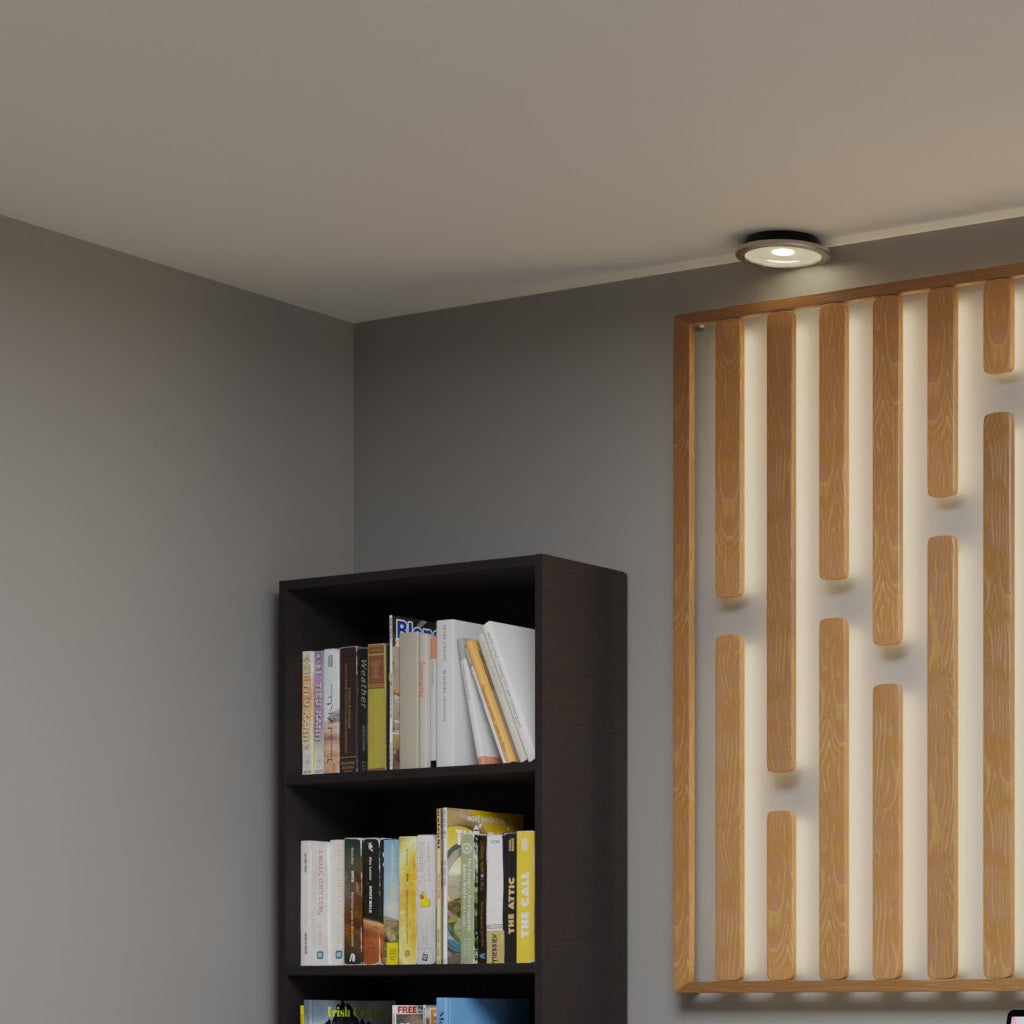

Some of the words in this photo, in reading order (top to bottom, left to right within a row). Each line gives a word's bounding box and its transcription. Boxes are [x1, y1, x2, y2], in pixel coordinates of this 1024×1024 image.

[360, 659, 368, 710] Weather
[507, 877, 516, 909] ATTIC
[520, 872, 530, 907] CALL
[507, 912, 515, 935] THE
[520, 910, 530, 938] THE
[327, 1006, 351, 1018] Irish
[397, 1006, 417, 1014] FREE
